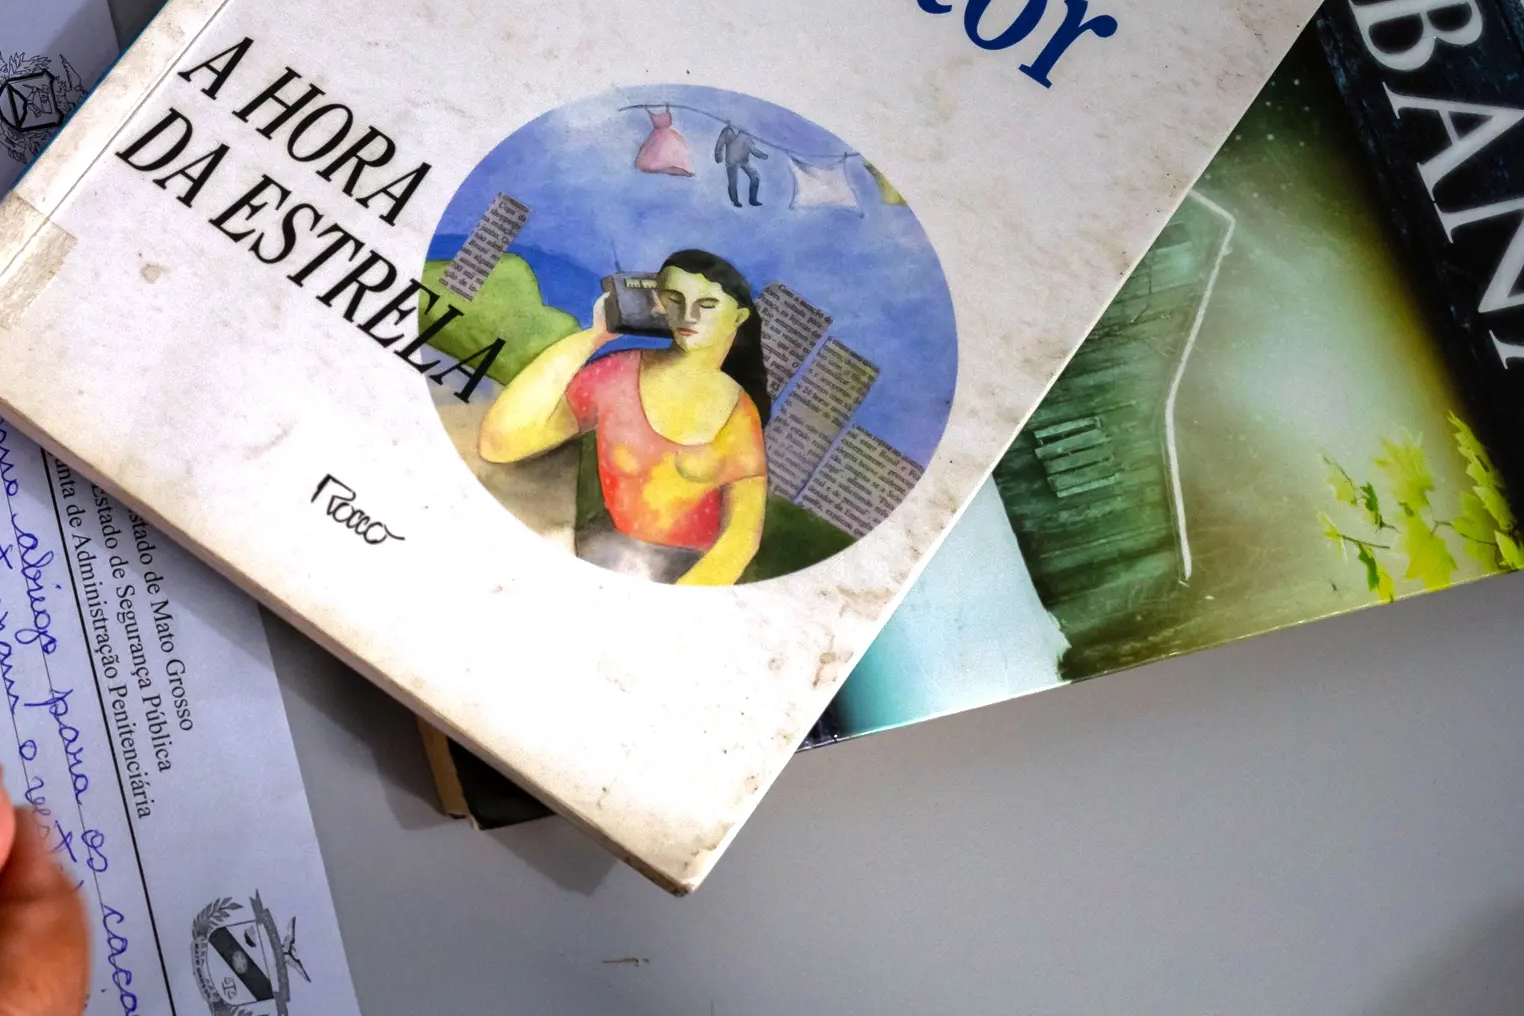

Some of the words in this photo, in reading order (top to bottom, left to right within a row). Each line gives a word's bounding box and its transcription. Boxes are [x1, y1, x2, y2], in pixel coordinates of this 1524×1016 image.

[178, 36, 255, 100] A
[232, 66, 433, 227] HORA
[115, 107, 231, 208] DA
[209, 174, 507, 405] ESTRELA
[45, 451, 81, 504] unta
[65, 503, 87, 528] de
[123, 503, 158, 566] stado
[108, 555, 130, 579] de
[143, 570, 165, 595] de
[71, 533, 120, 685] Administração
[115, 584, 152, 690] Segurança
[150, 598, 175, 653] Mato
[165, 658, 194, 731] Grosso
[107, 684, 151, 825] Penitenciária
[141, 694, 173, 773] Pública
